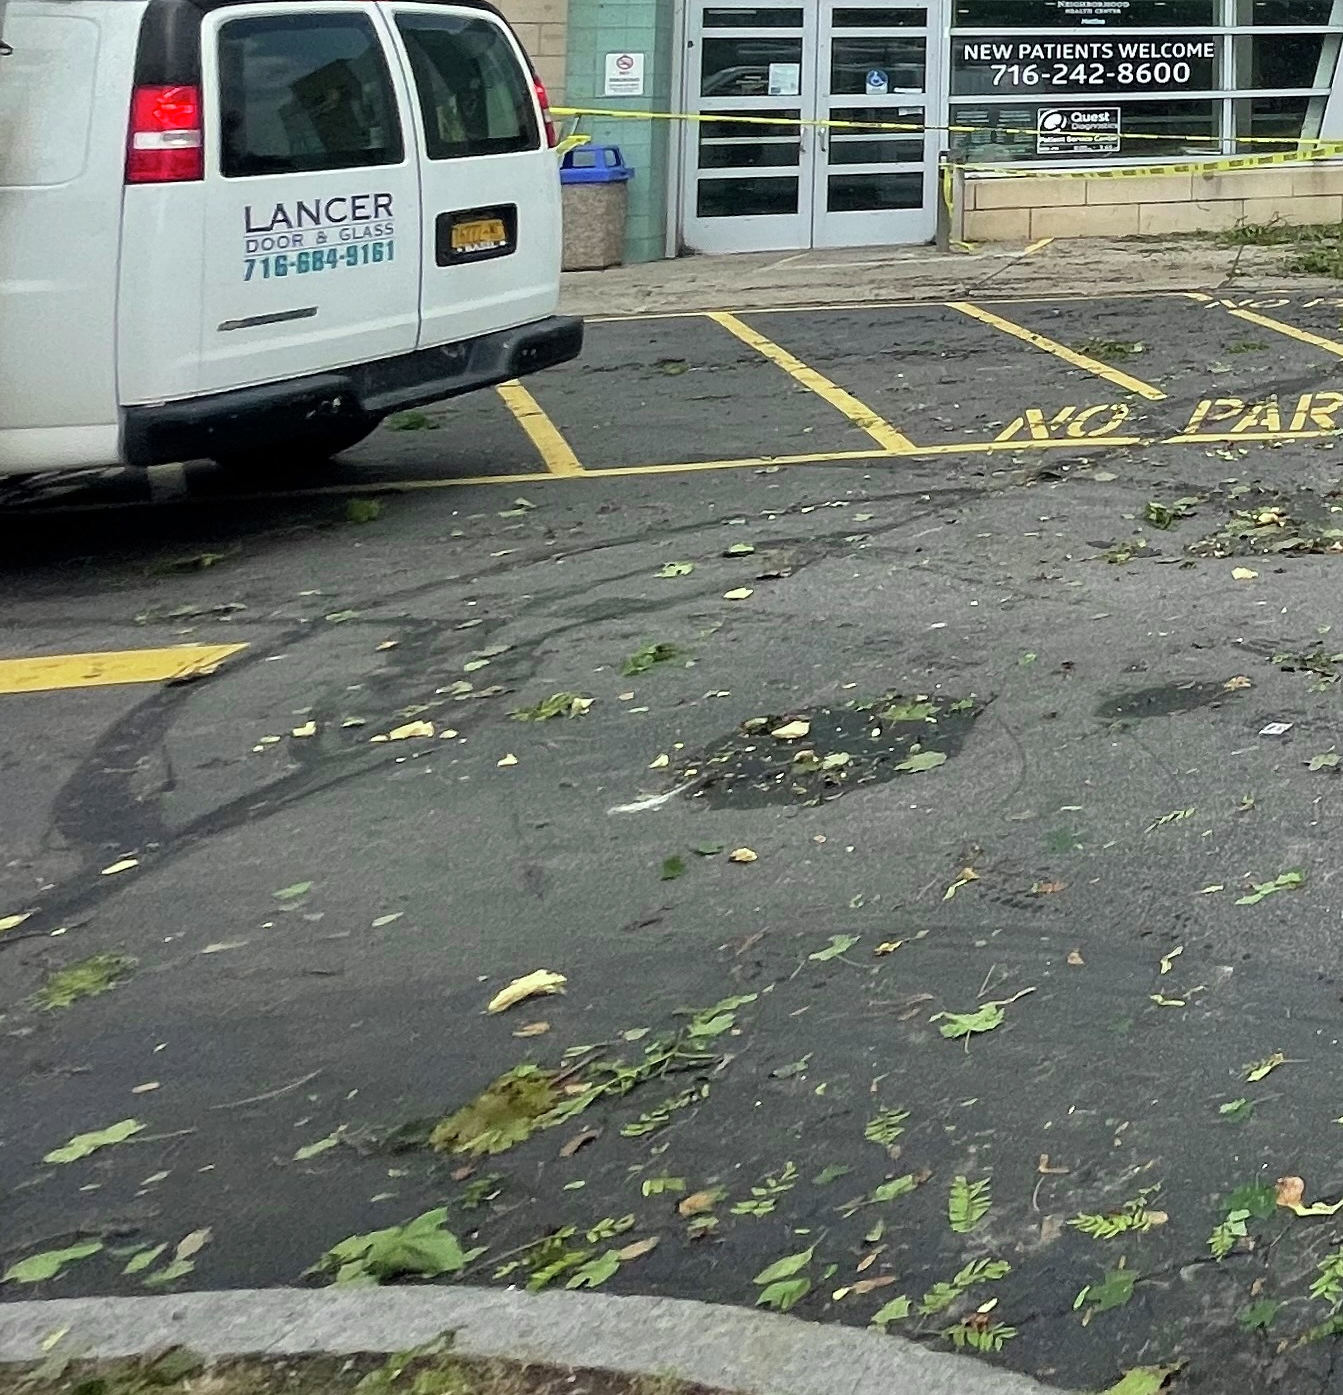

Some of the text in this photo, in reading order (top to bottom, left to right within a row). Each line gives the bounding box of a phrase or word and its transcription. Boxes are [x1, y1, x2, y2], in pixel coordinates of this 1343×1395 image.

[963, 42, 1215, 60] NEW PATIENTS WELCOME
[990, 62, 1191, 85] 716-242-8600
[1070, 111, 1110, 123] Quest
[244, 192, 393, 234] LANCER
[246, 222, 395, 254] DOOR & GLASS
[243, 240, 395, 282] 716-684-9161
[995, 403, 1129, 442] NO
